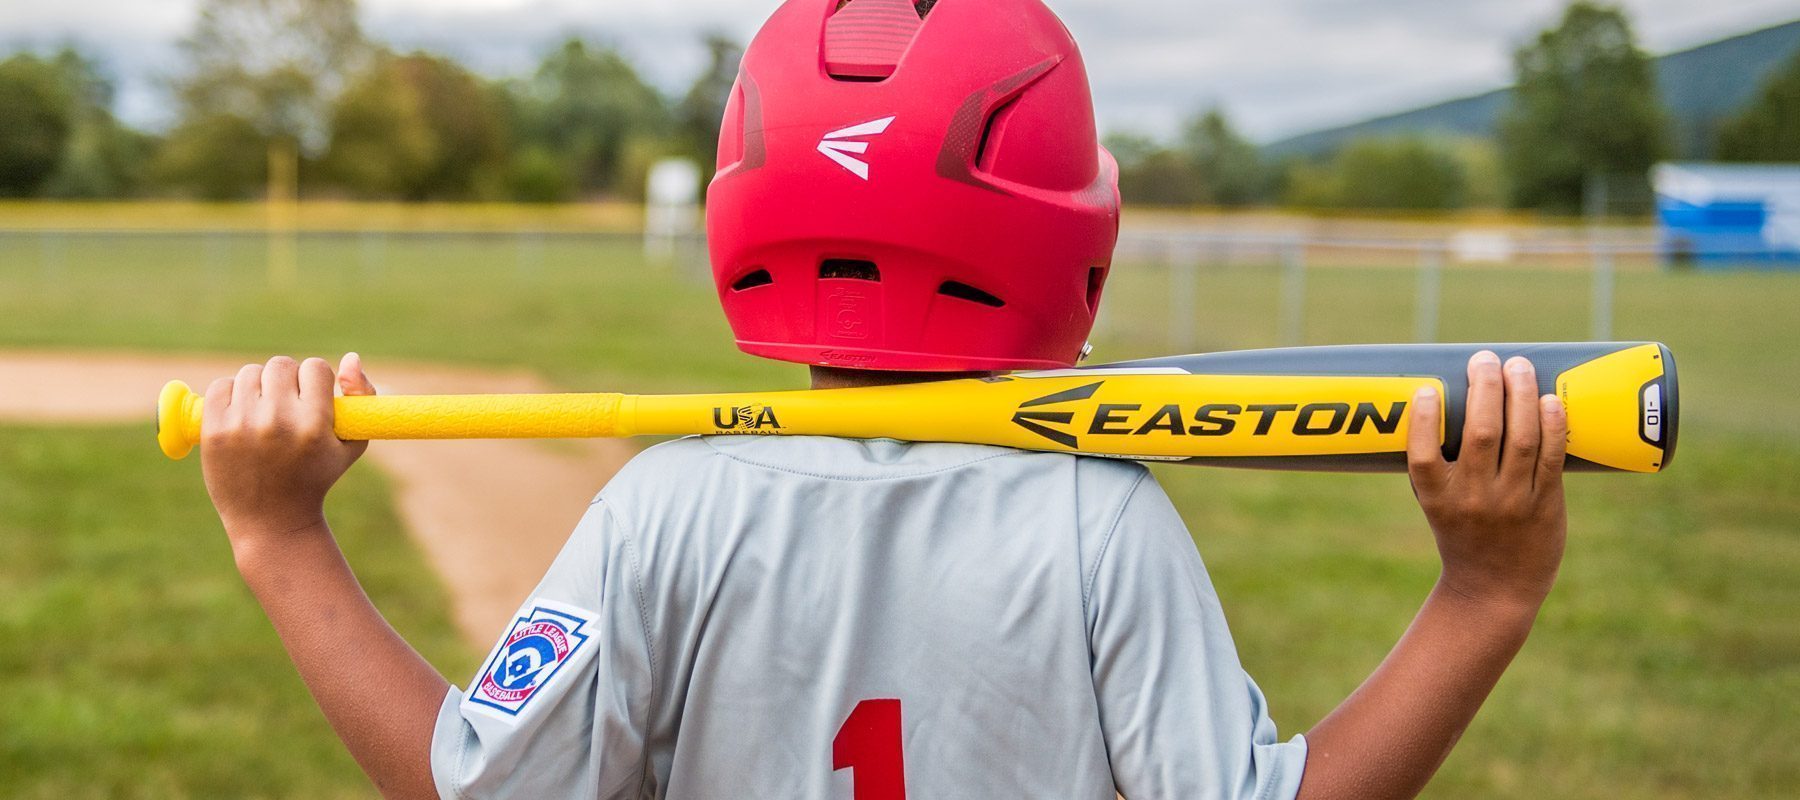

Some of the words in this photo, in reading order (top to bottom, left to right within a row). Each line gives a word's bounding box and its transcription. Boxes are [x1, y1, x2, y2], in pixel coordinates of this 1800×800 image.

[829, 353, 876, 363] EASTON
[713, 406, 781, 429] USA
[1086, 400, 1408, 436] EASTON
[513, 624, 543, 641] LITTLE
[544, 624, 568, 654] LEAGUE
[484, 681, 523, 701] BASEBALL
[832, 698, 906, 800] 1
